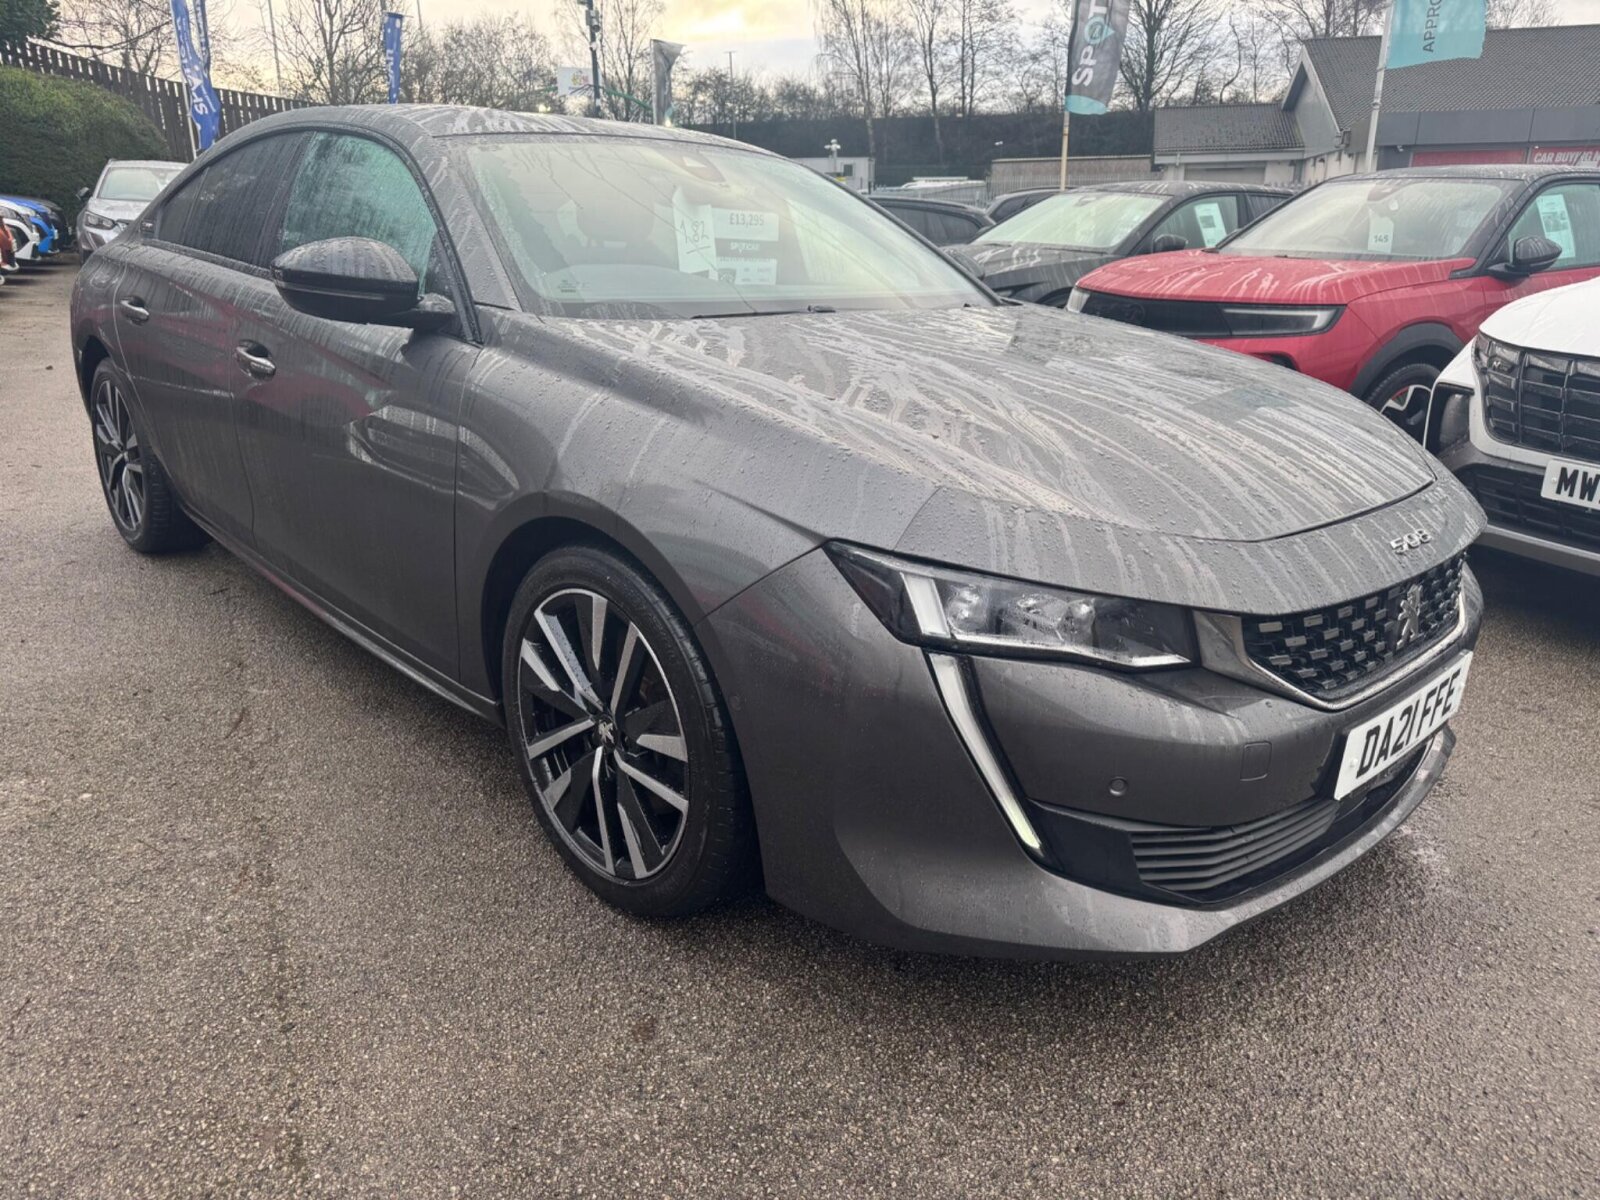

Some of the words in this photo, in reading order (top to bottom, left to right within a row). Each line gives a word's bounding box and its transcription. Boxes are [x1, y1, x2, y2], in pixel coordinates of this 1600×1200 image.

[1534, 152, 1555, 163] CAR
[729, 212, 765, 228] £13,295
[1390, 529, 1432, 553] 508
